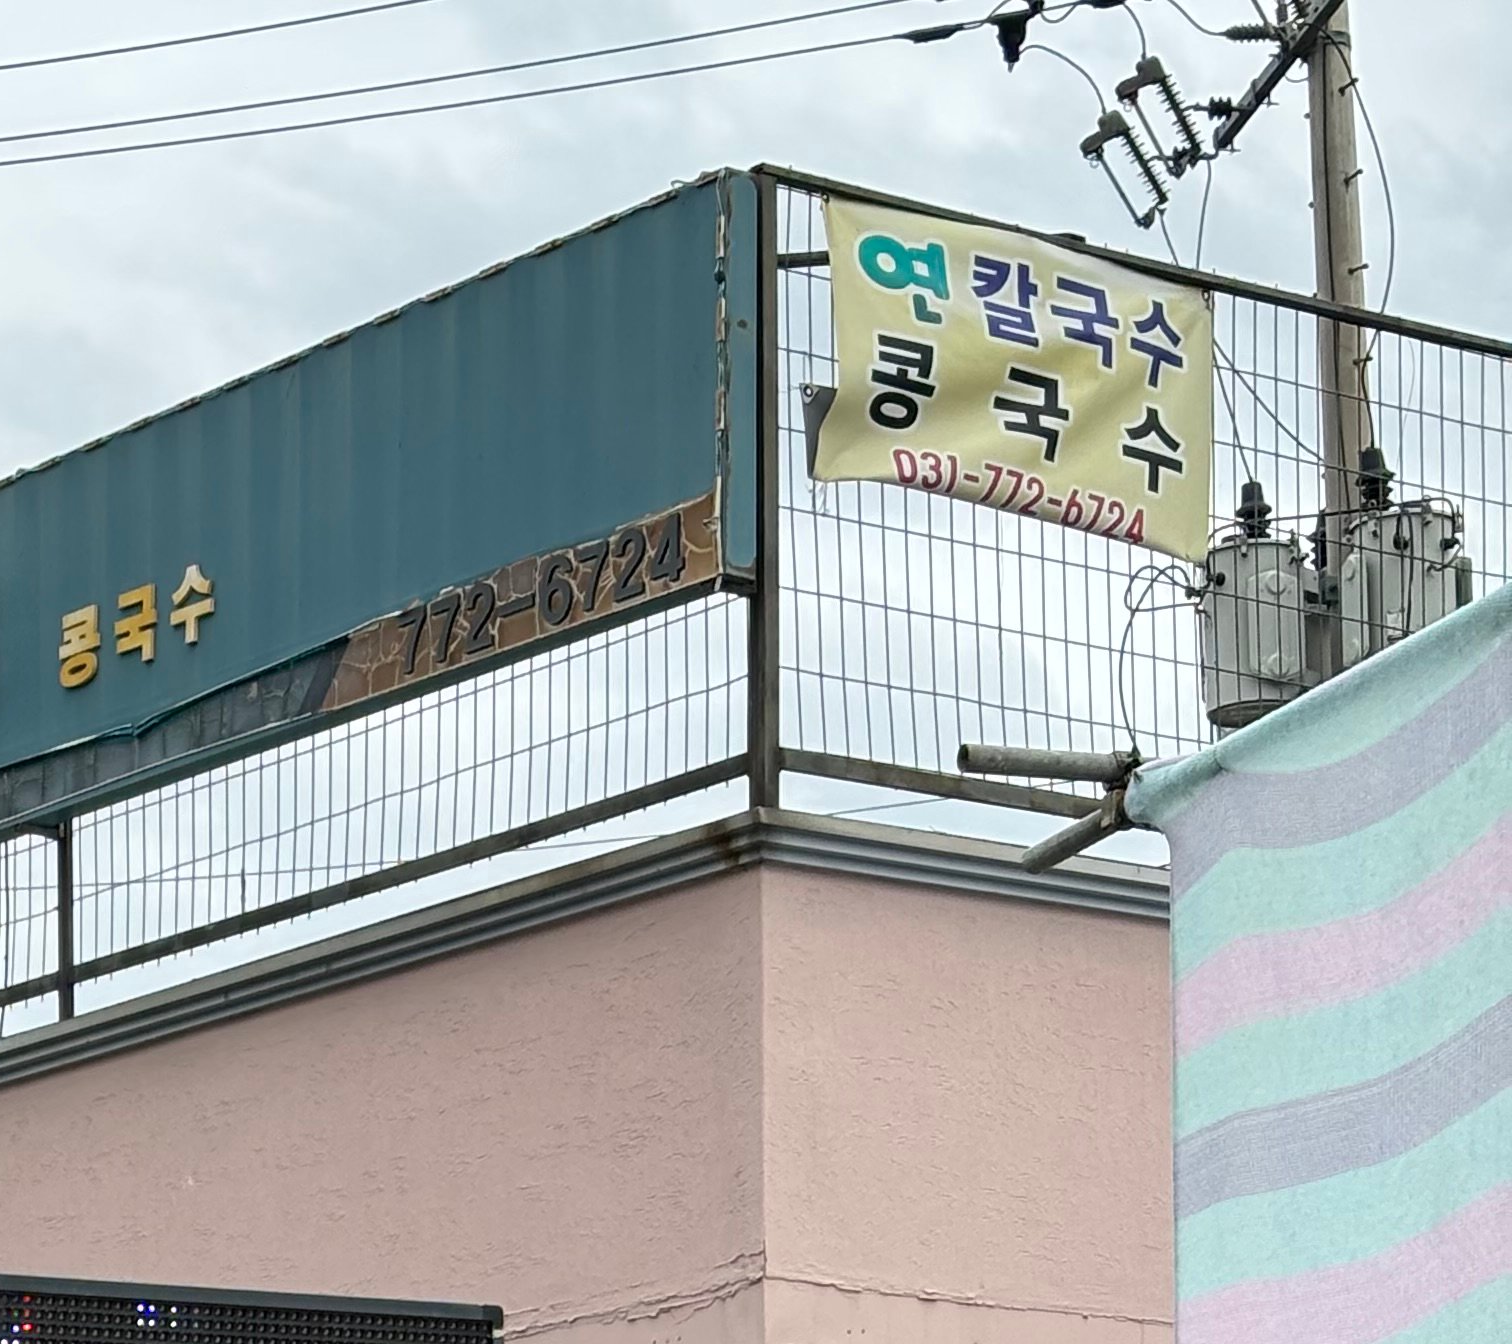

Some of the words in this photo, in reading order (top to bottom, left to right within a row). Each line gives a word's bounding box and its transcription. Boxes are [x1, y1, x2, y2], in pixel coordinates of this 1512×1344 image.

[858, 235, 951, 325] 연
[971, 254, 1184, 388] 칼국수
[892, 448, 1145, 545] 031-772-6724
[58, 565, 215, 689] 콩국수
[397, 513, 687, 675] 772-6724
